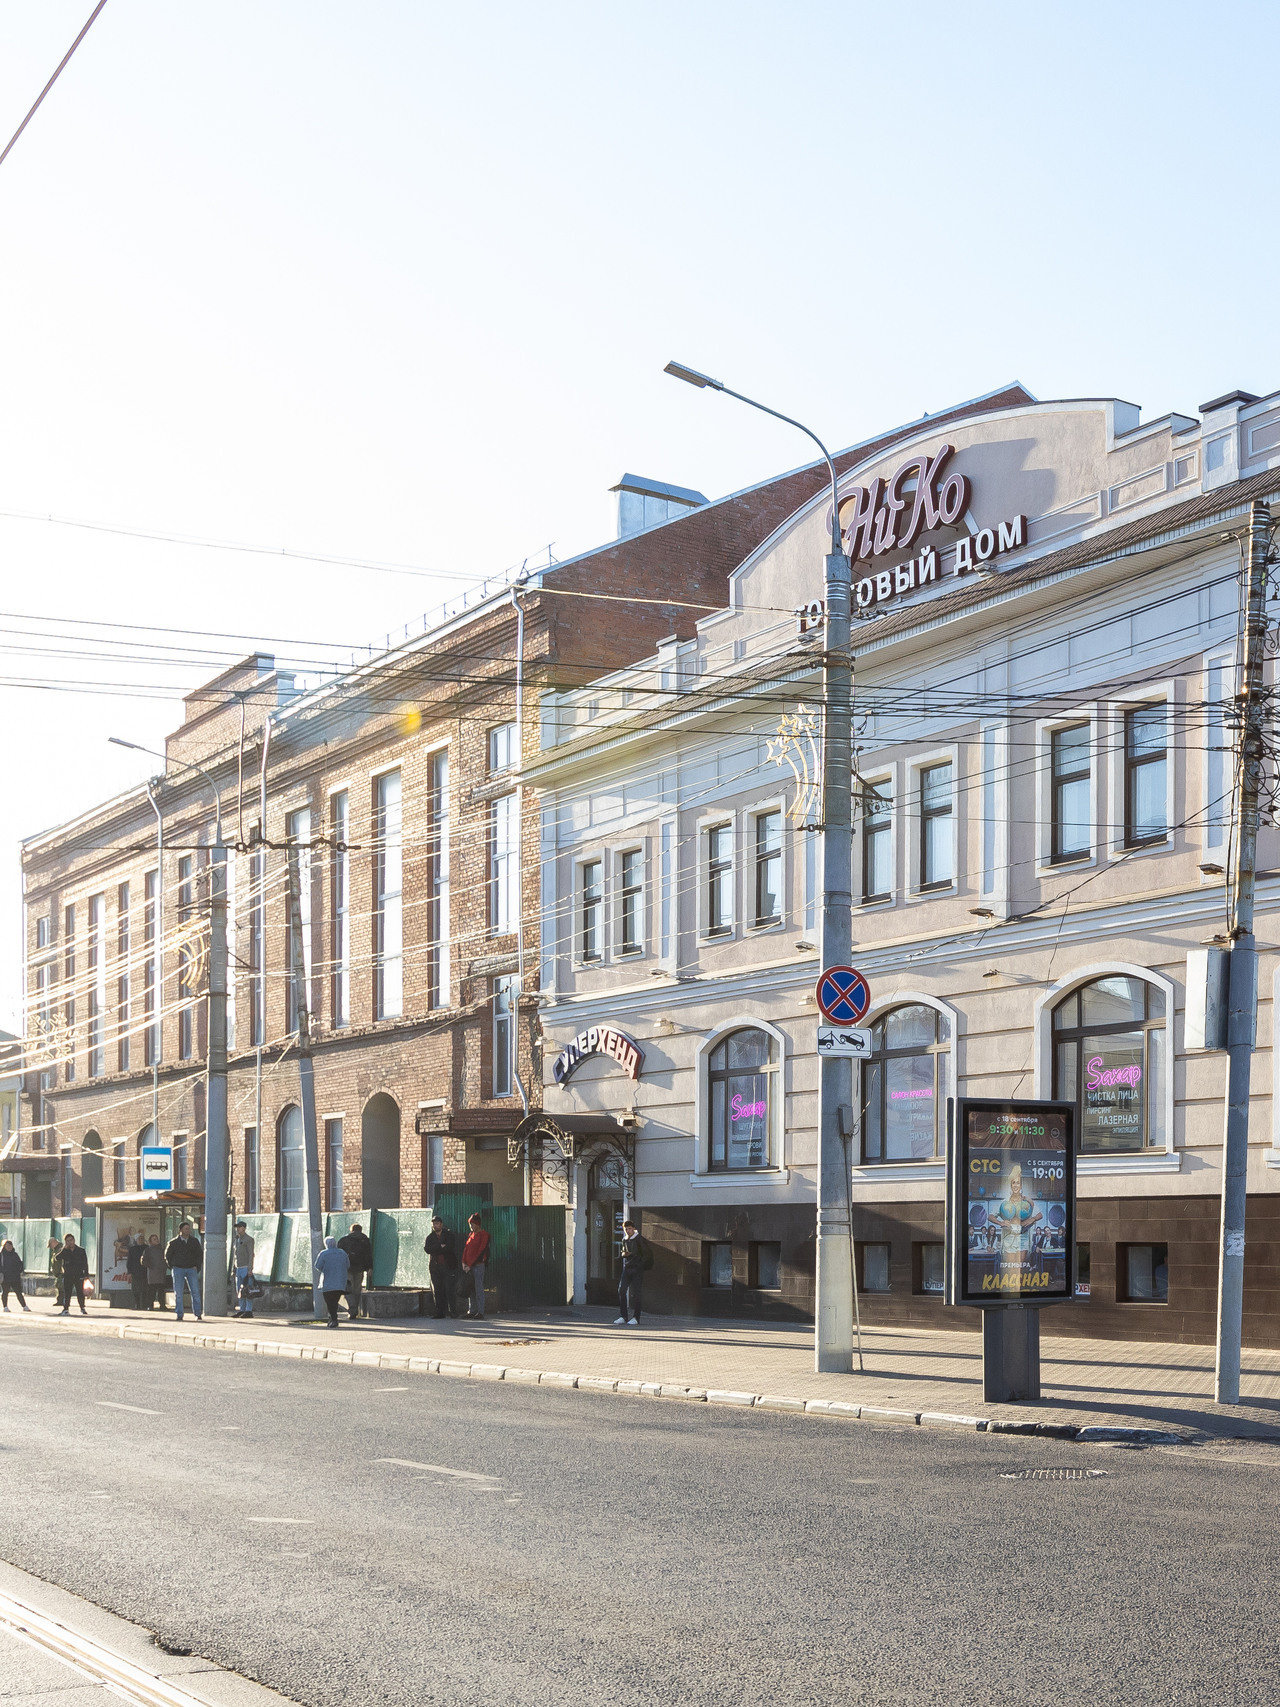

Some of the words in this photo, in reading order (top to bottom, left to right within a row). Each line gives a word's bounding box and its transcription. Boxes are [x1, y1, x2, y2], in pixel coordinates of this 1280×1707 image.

[825, 443, 970, 562] НиКо
[795, 545, 940, 633] ТООВЫЙ
[954, 514, 1027, 577] ДОМ
[552, 1027, 640, 1083] СУПЕРХЕНД
[1087, 1090, 1116, 1101] ЧИСТКА
[1118, 1090, 1139, 1100] ЛИЦА
[1087, 1107, 1112, 1115] ПИРСИНГ
[1010, 1116, 1038, 1124] сентября
[1098, 1114, 1139, 1125] ЛАЗЕРНАЯ
[989, 1124, 1013, 1135] 9:30
[1019, 1125, 1045, 1136] 11:30
[970, 1159, 1001, 1173] СТС
[1032, 1167, 1064, 1179] 19:00
[981, 1271, 1049, 1291] КЛАССНАЯ
